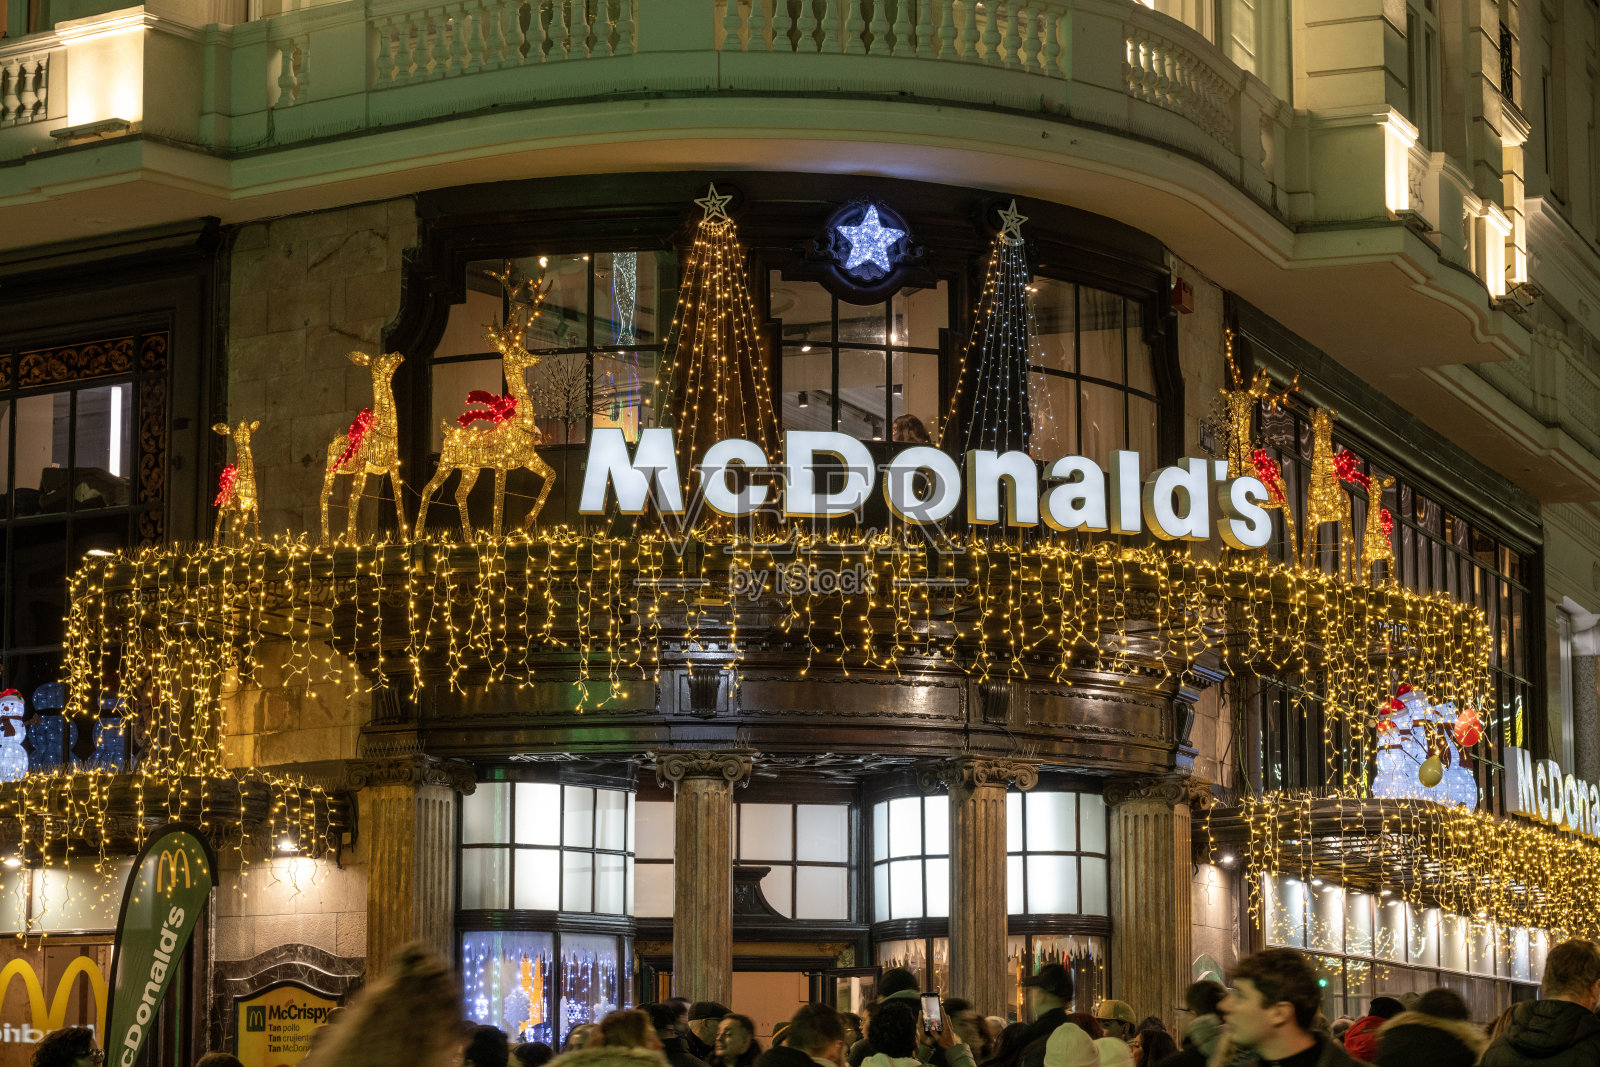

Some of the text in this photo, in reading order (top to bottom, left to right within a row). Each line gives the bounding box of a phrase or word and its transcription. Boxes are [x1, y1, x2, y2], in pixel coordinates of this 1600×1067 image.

[579, 427, 1272, 550] McDonald's
[1506, 747, 1600, 839] McDona
[268, 1003, 330, 1023] McCrispy
[268, 1034, 281, 1042] Tan
[283, 1024, 300, 1033] pollo
